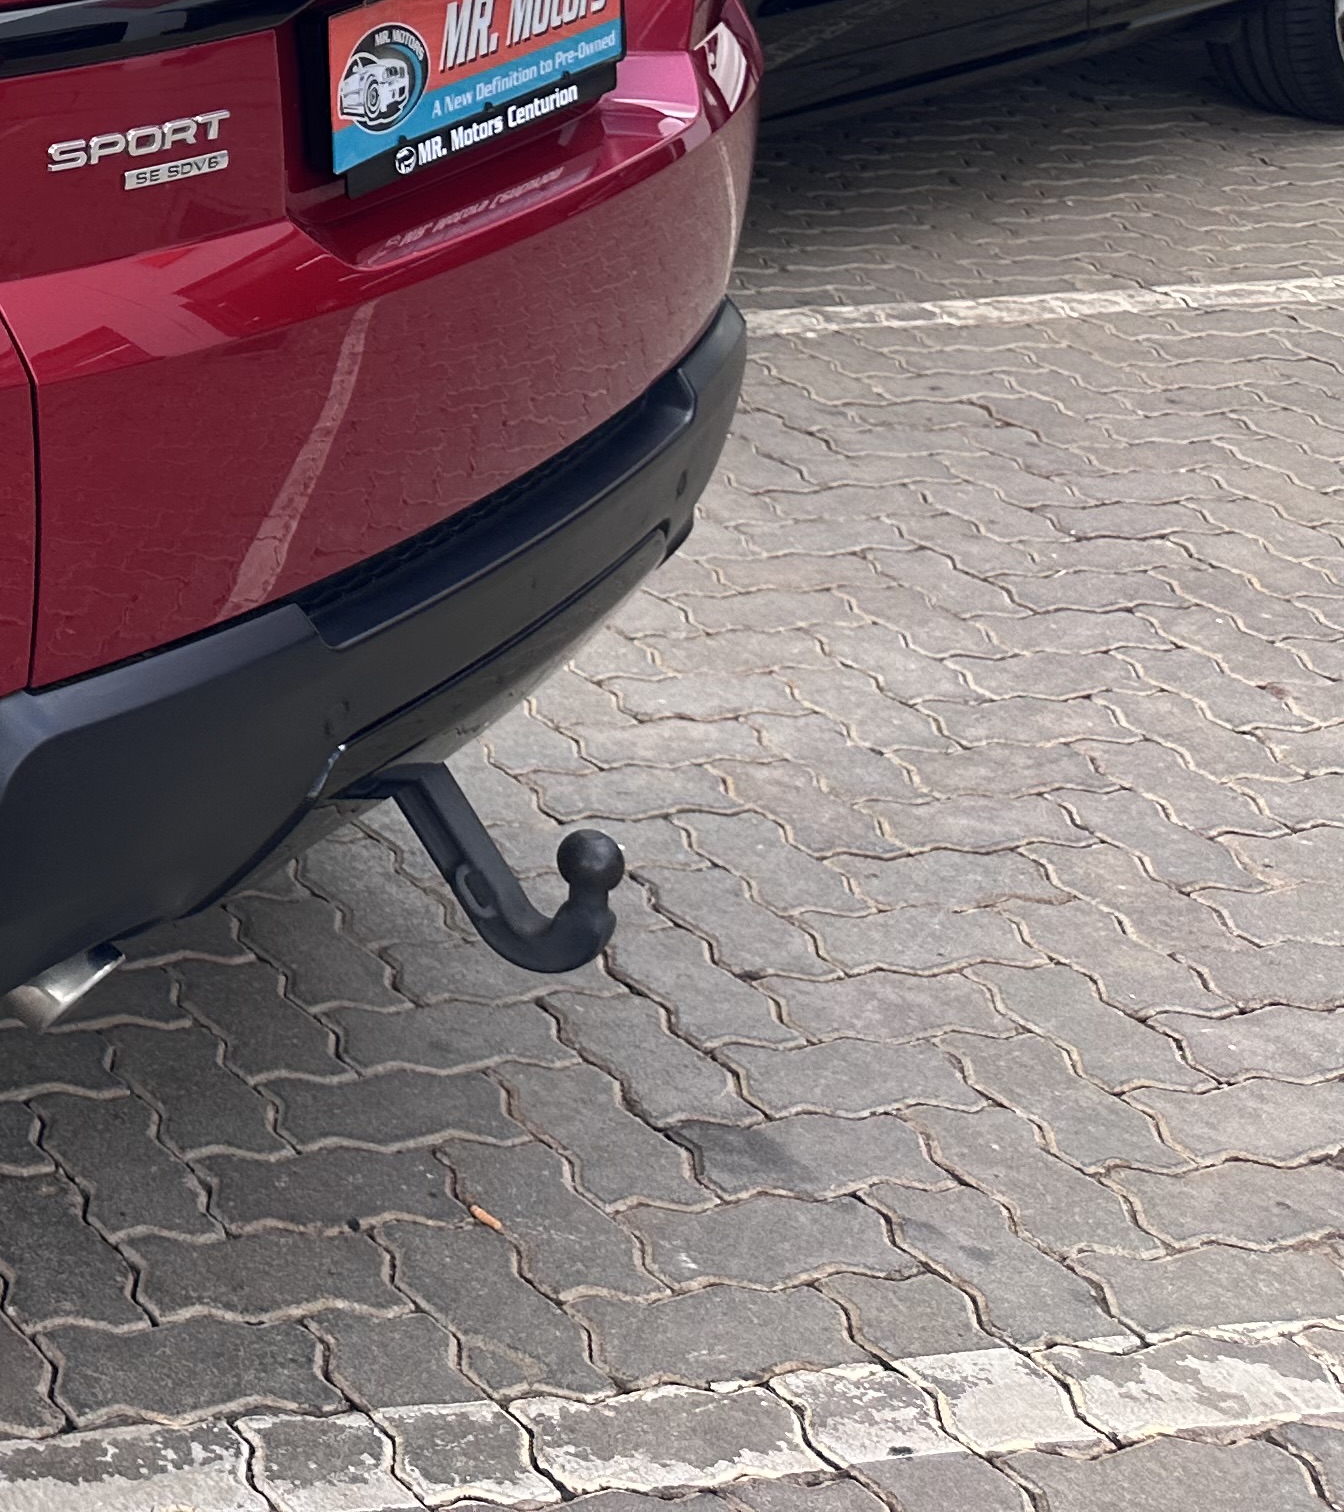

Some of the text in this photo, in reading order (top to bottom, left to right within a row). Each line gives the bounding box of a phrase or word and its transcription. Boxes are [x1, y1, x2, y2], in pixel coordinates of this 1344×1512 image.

[432, 30, 616, 119] A New Definition to Pre-Owned
[47, 109, 231, 172] SPORT
[418, 84, 578, 166] MR. Motors Centurion
[136, 156, 219, 185] SE SDV6
